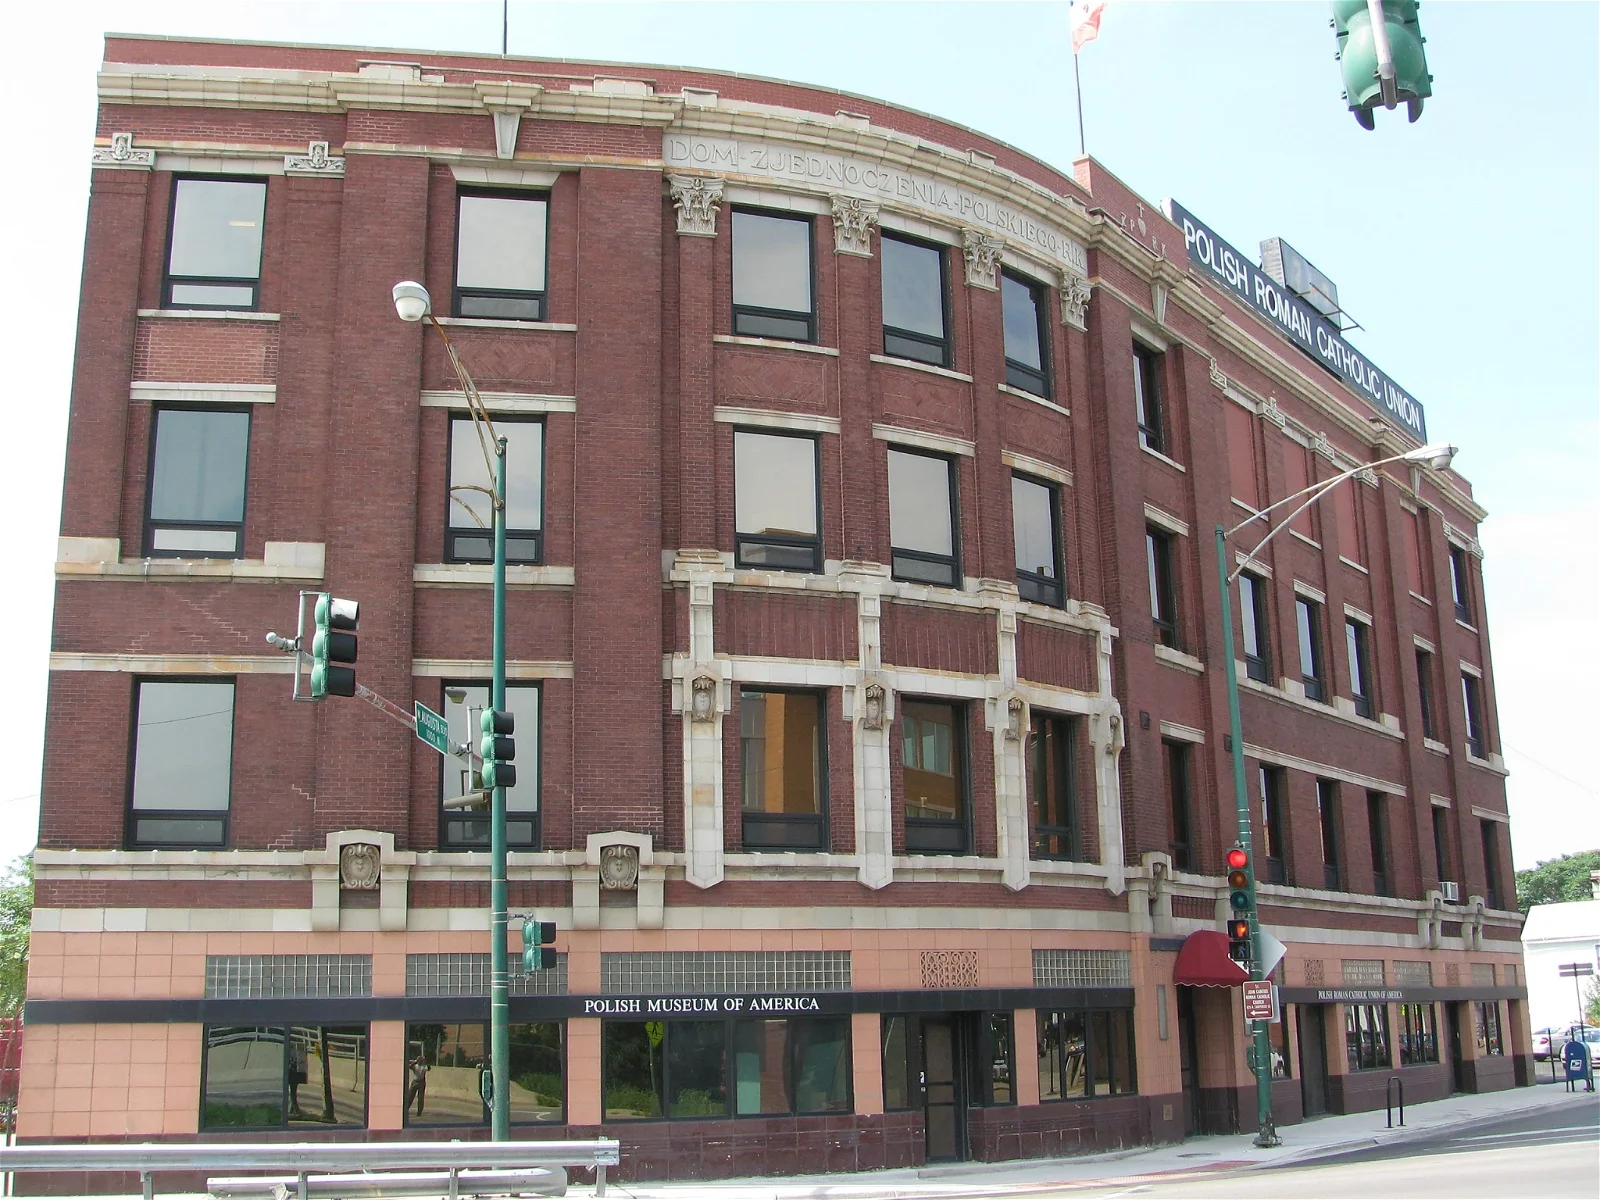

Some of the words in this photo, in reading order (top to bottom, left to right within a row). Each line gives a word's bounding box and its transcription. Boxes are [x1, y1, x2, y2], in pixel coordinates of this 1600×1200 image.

[670, 139, 738, 167] DOM
[750, 150, 953, 211] ZJEDNOCZENIA
[959, 193, 1057, 253] POLSKIEGO
[1182, 217, 1250, 296] POLISH
[1254, 274, 1312, 345] ROMAN
[1316, 326, 1382, 400] CATHOLIC
[1382, 380, 1421, 432] UNION
[584, 999, 641, 1014] POLISH
[647, 998, 718, 1013] MUSEUM
[723, 998, 744, 1012] OF
[748, 997, 820, 1011] AMERICA
[1318, 990, 1333, 1000] POLISH
[1333, 990, 1348, 1000] ROMAN
[1348, 990, 1367, 1000] CATHOLIC
[1368, 990, 1380, 999] UNION
[1386, 990, 1403, 999] AMERICA
